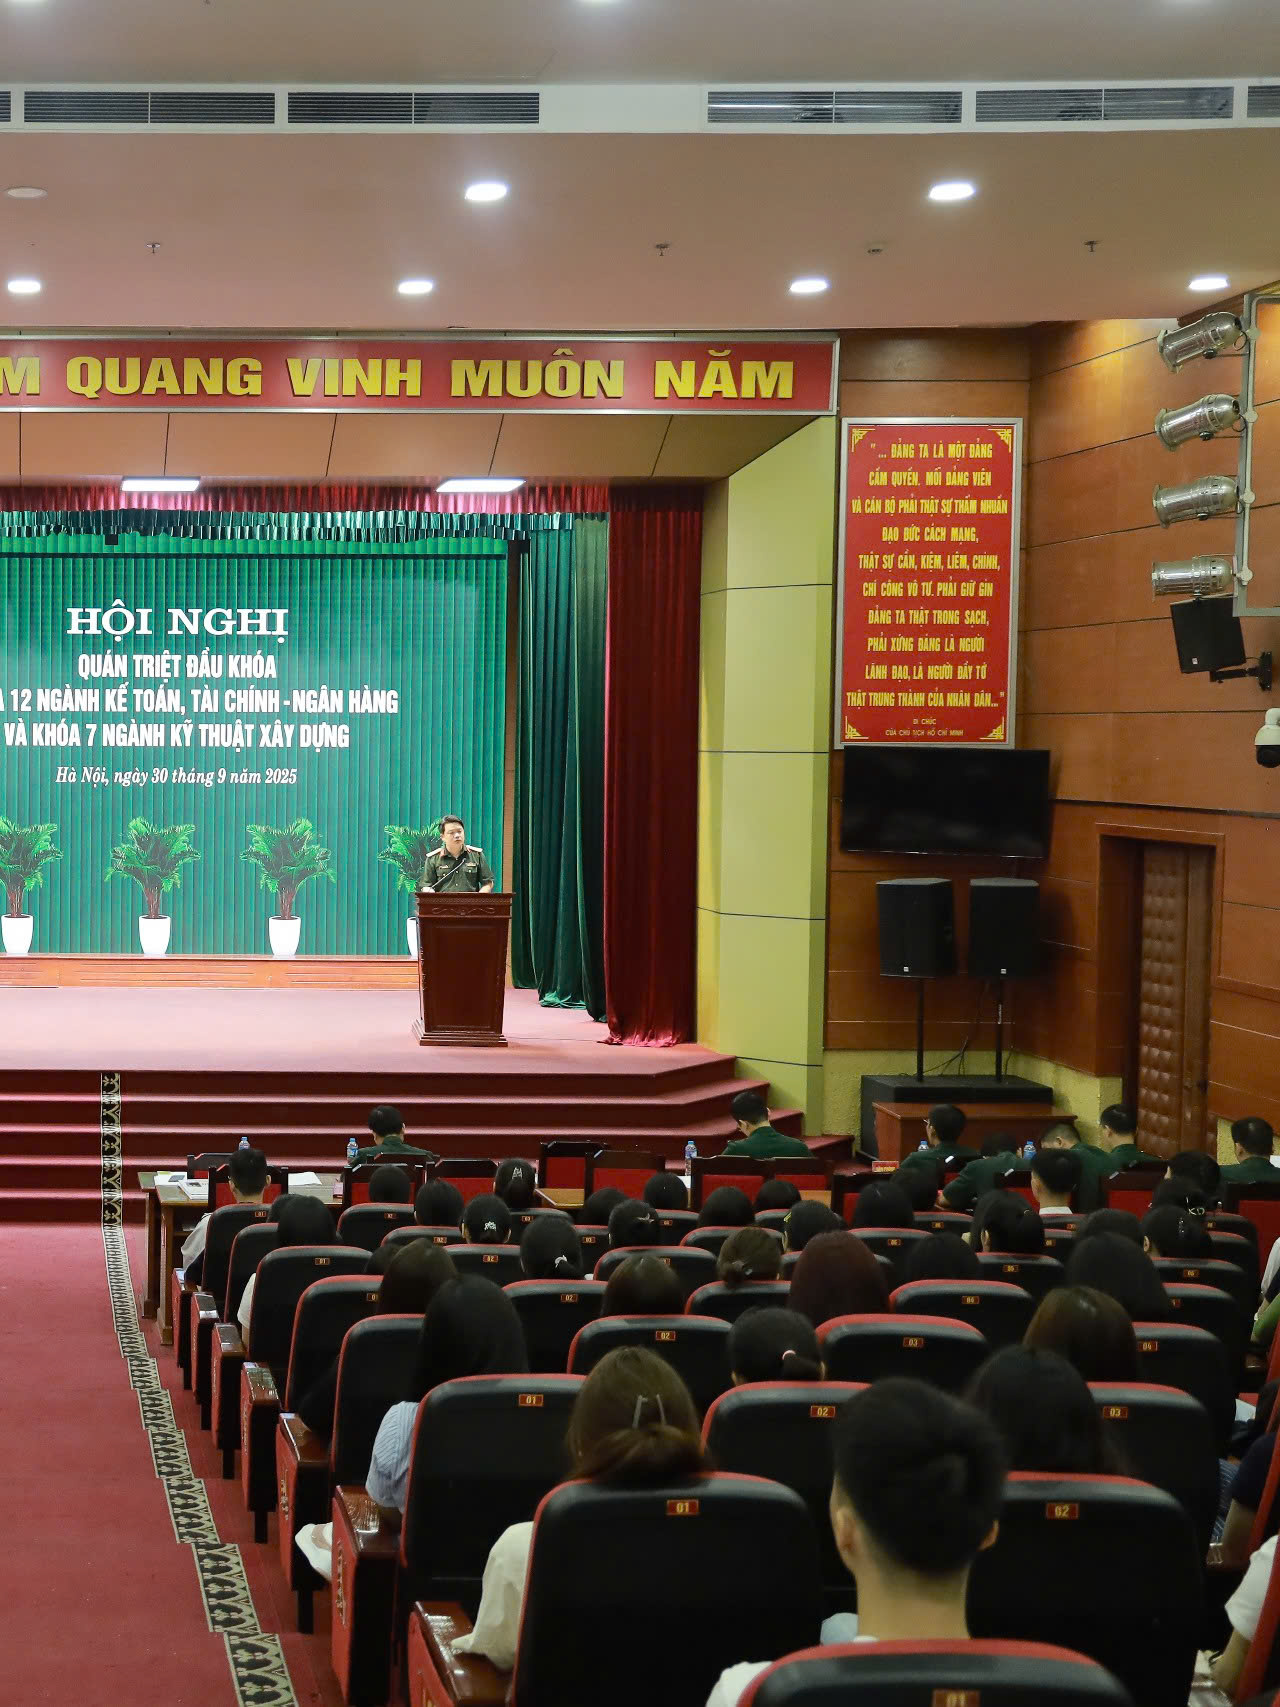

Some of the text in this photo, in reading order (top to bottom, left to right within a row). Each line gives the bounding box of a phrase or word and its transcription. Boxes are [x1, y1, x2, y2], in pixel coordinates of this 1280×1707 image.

[67, 357, 261, 398] QUANG
[288, 356, 421, 400] VINH
[452, 349, 629, 401] MUÔN
[655, 350, 793, 398] NĂM
[919, 444, 929, 458] TA
[933, 441, 944, 458] LÀ
[67, 599, 288, 643] HỘI NGHỊ
[79, 647, 276, 681] QUÁN TRIỆT ĐẦU KHÓA
[11, 689, 31, 711] 12
[37, 684, 99, 712] NGÀNH
[105, 680, 129, 712] KẾ
[133, 684, 185, 715] TOÁN,
[191, 685, 218, 712] TÀI
[225, 685, 279, 712] CHÍNH
[349, 685, 398, 713] HÀNG
[4, 718, 349, 752] VÀ KHÓA 7 NGÀNH KỸ THUẬT XÂY DỰNG
[56, 767, 297, 787] Hà Nội, ngày 30 tháng 9 năm 2025
[661, 1331, 670, 1340] 02
[525, 1395, 536, 1405] 01
[817, 1407, 829, 1417] 02
[1110, 1408, 1120, 1417] 03
[676, 1501, 690, 1513] 01
